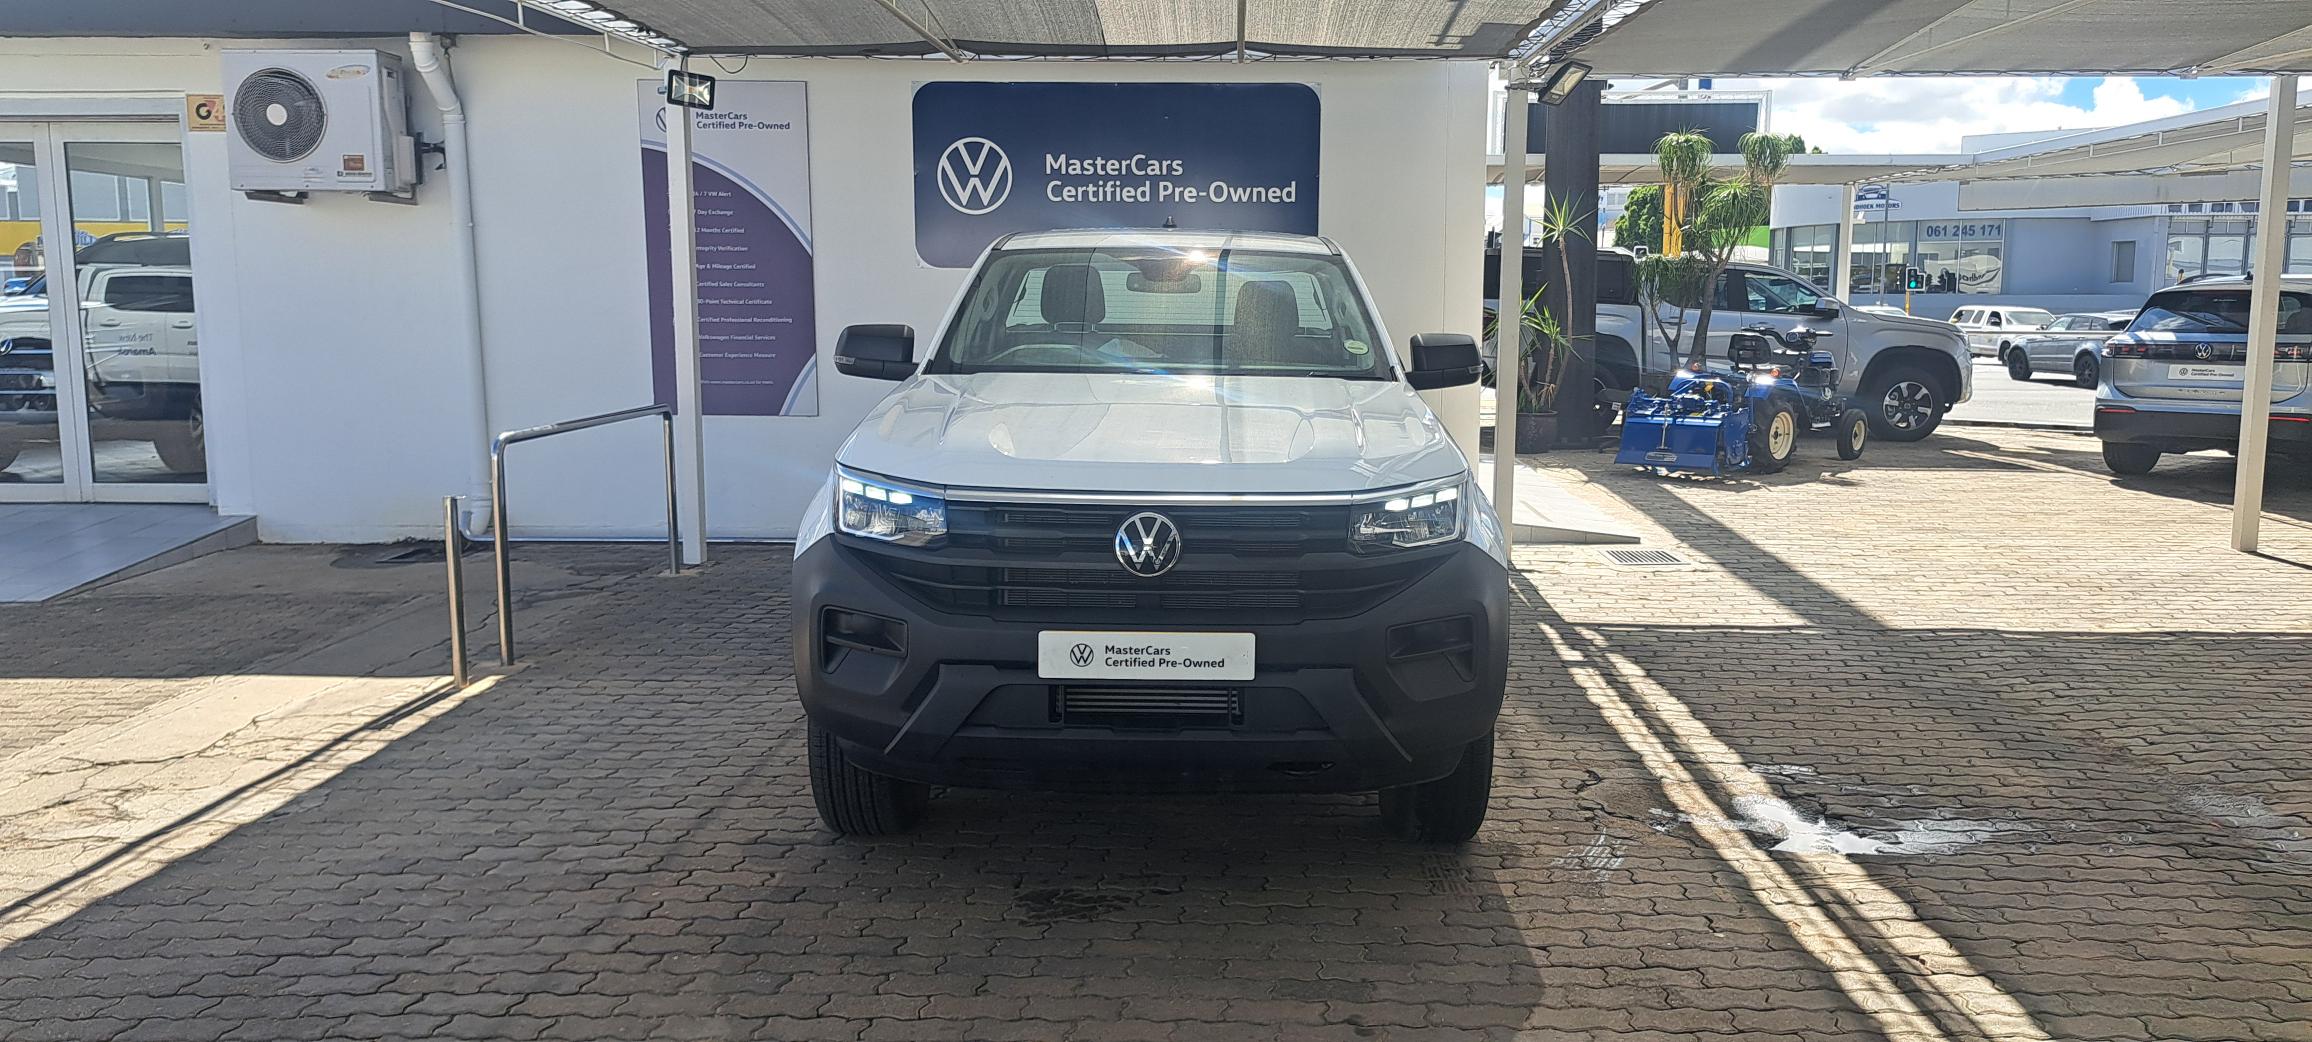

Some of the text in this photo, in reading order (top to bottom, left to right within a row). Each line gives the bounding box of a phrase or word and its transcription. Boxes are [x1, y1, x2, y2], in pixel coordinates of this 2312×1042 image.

[695, 112, 748, 120] MasterCars
[696, 121, 791, 130] Certified Pre-Owned
[1045, 153, 1184, 176] MasterCars
[1046, 180, 1297, 204] Certified Pre-Owned
[708, 209, 734, 217] Exchange
[1926, 224, 2001, 238] 061 245 171
[1104, 645, 1171, 656] MasterCars
[1105, 657, 1225, 669] Certified Pre-Owned
